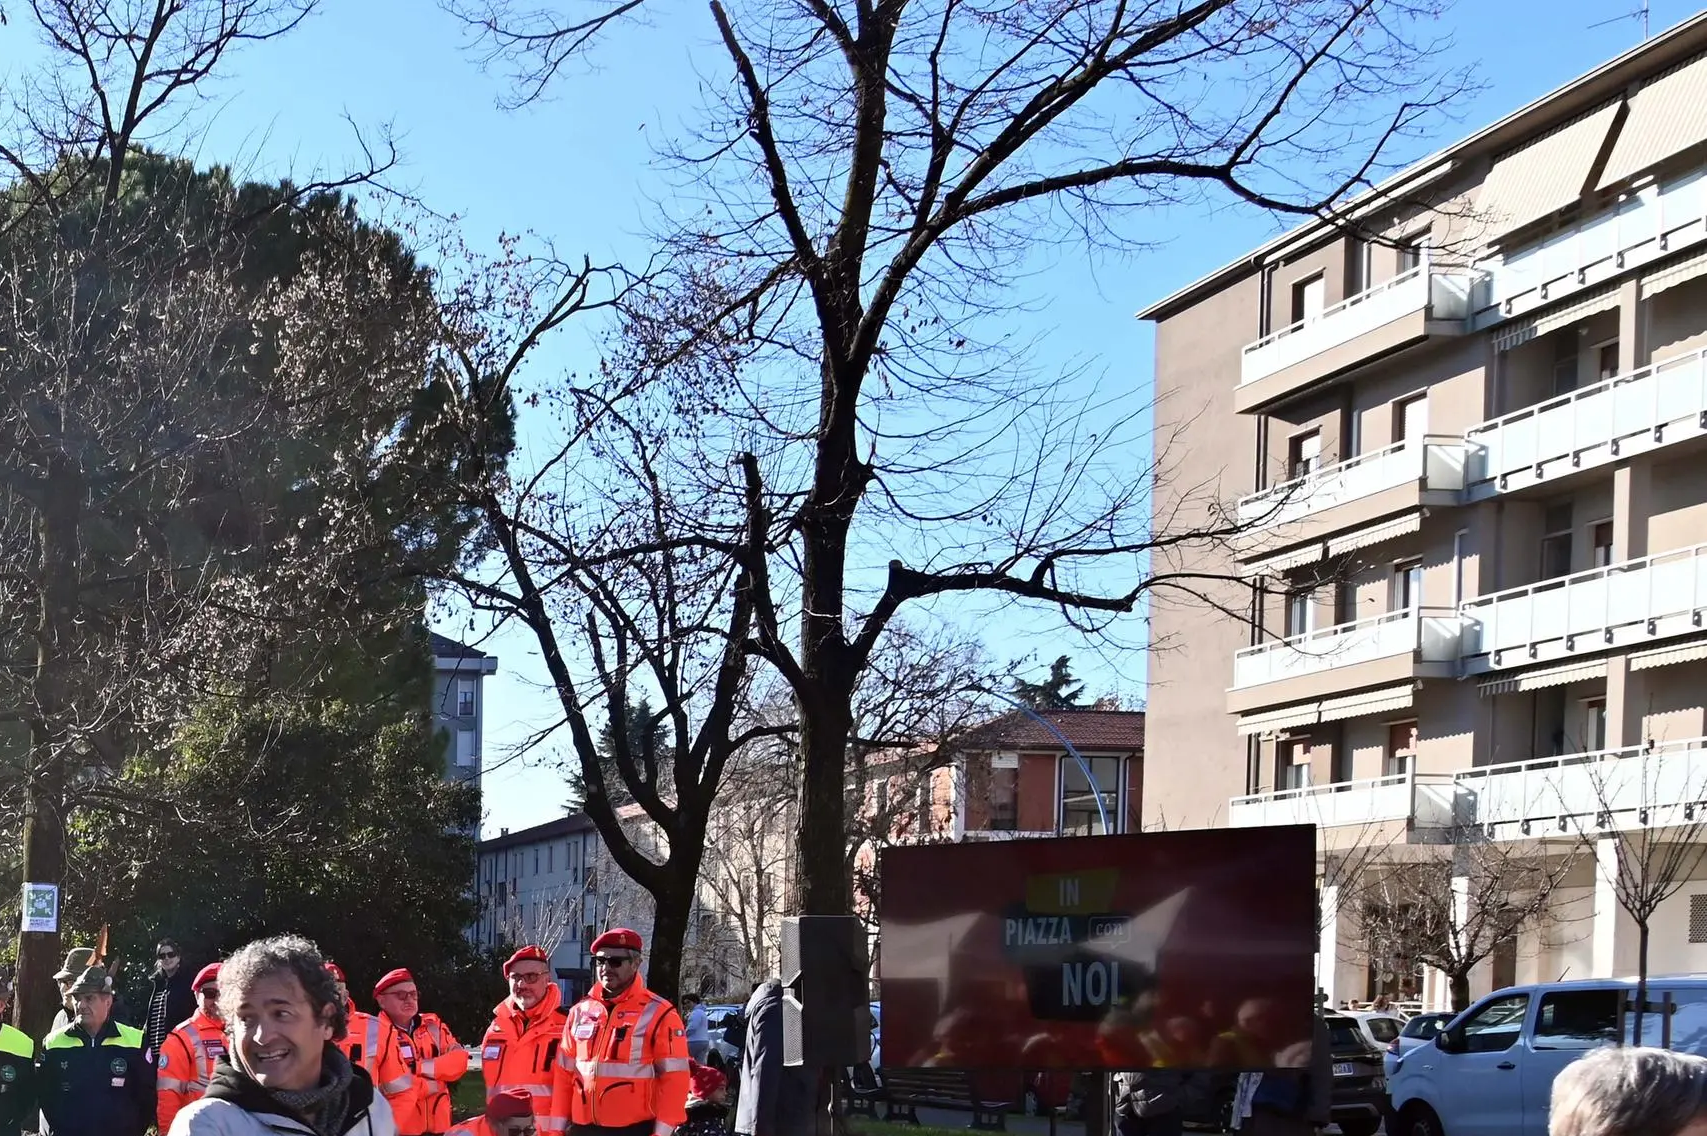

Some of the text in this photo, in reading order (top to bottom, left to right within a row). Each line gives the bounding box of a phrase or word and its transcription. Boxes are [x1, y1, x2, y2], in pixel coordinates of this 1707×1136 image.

[1059, 878, 1079, 906] IN
[1005, 917, 1125, 946] PIAZZA con
[1062, 961, 1119, 1006] NOI
